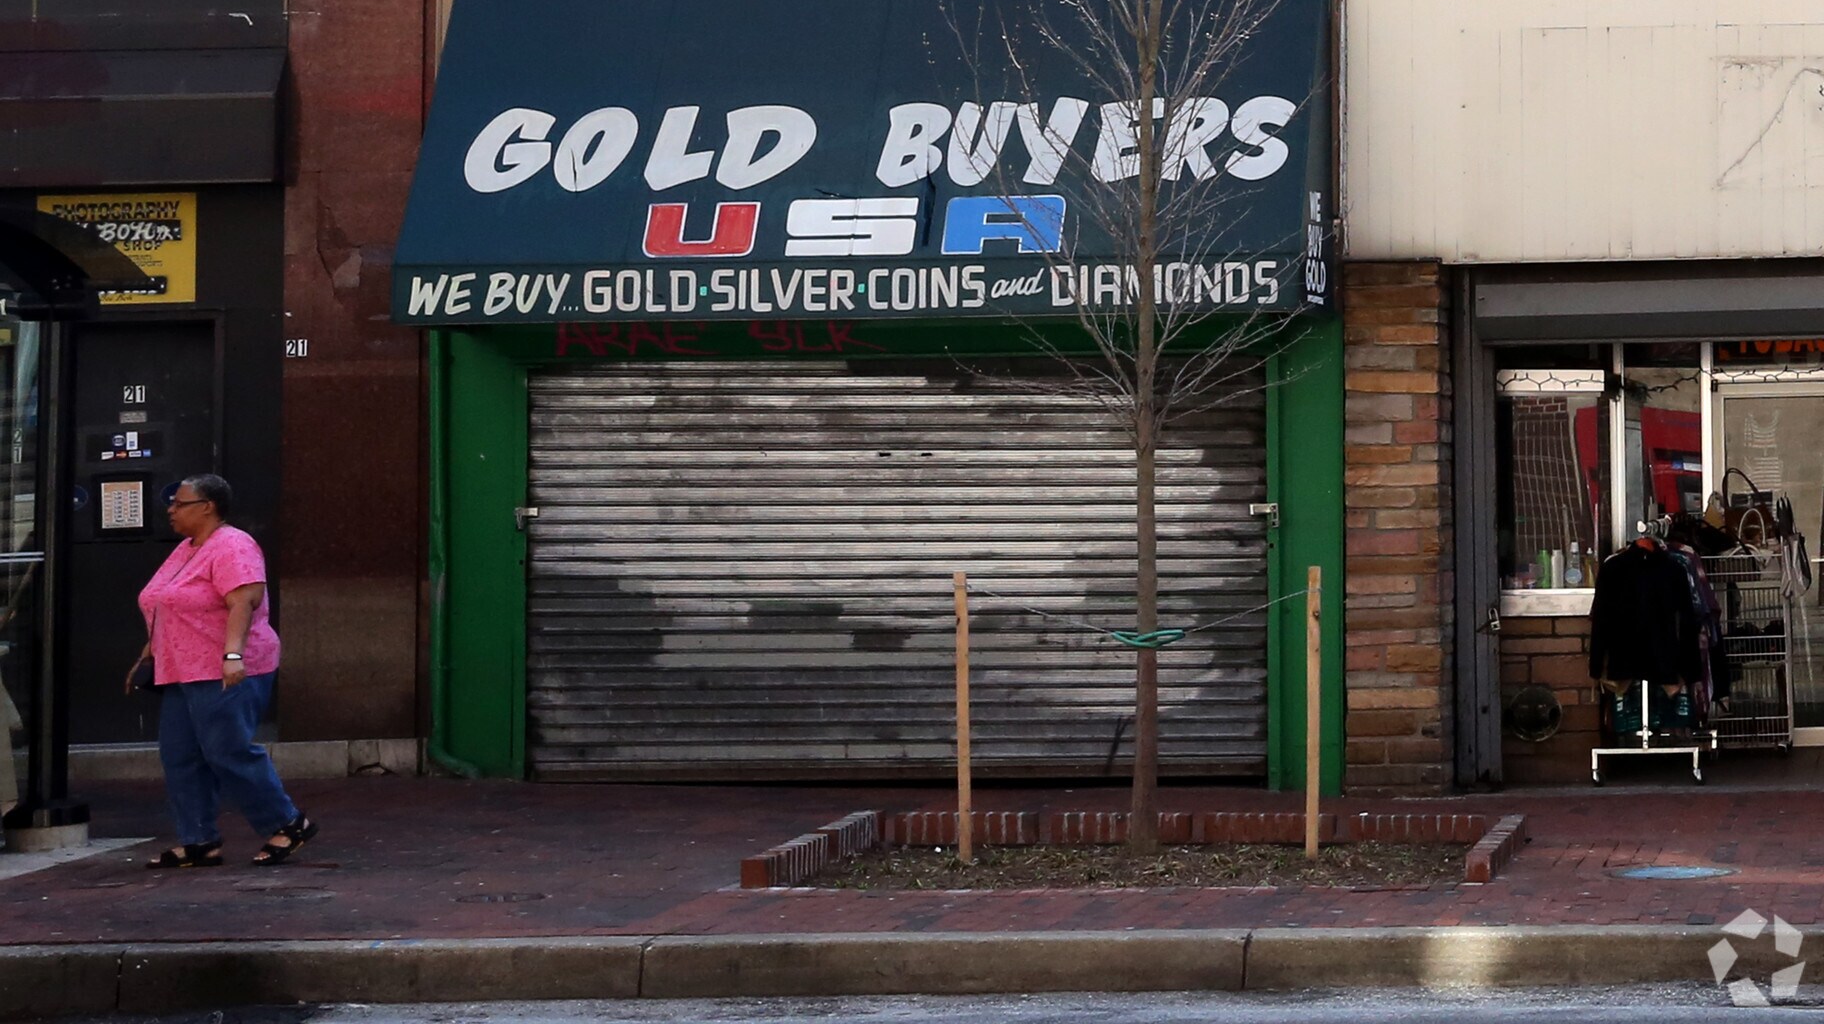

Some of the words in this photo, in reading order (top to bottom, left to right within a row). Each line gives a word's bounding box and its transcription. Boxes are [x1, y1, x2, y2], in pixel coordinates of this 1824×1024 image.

[463, 105, 818, 193] GOLD
[875, 95, 1298, 189] BUYERS
[52, 200, 180, 221] PHOTOGRAPHY
[642, 193, 1067, 259] USA
[407, 273, 477, 316] WE
[583, 269, 697, 314] GOLD
[710, 268, 856, 313] SILVER
[867, 264, 986, 311] COINS
[990, 267, 1044, 300] and
[1049, 259, 1280, 308] DIAMONDS
[285, 339, 308, 357] 21
[123, 385, 146, 403] 21
